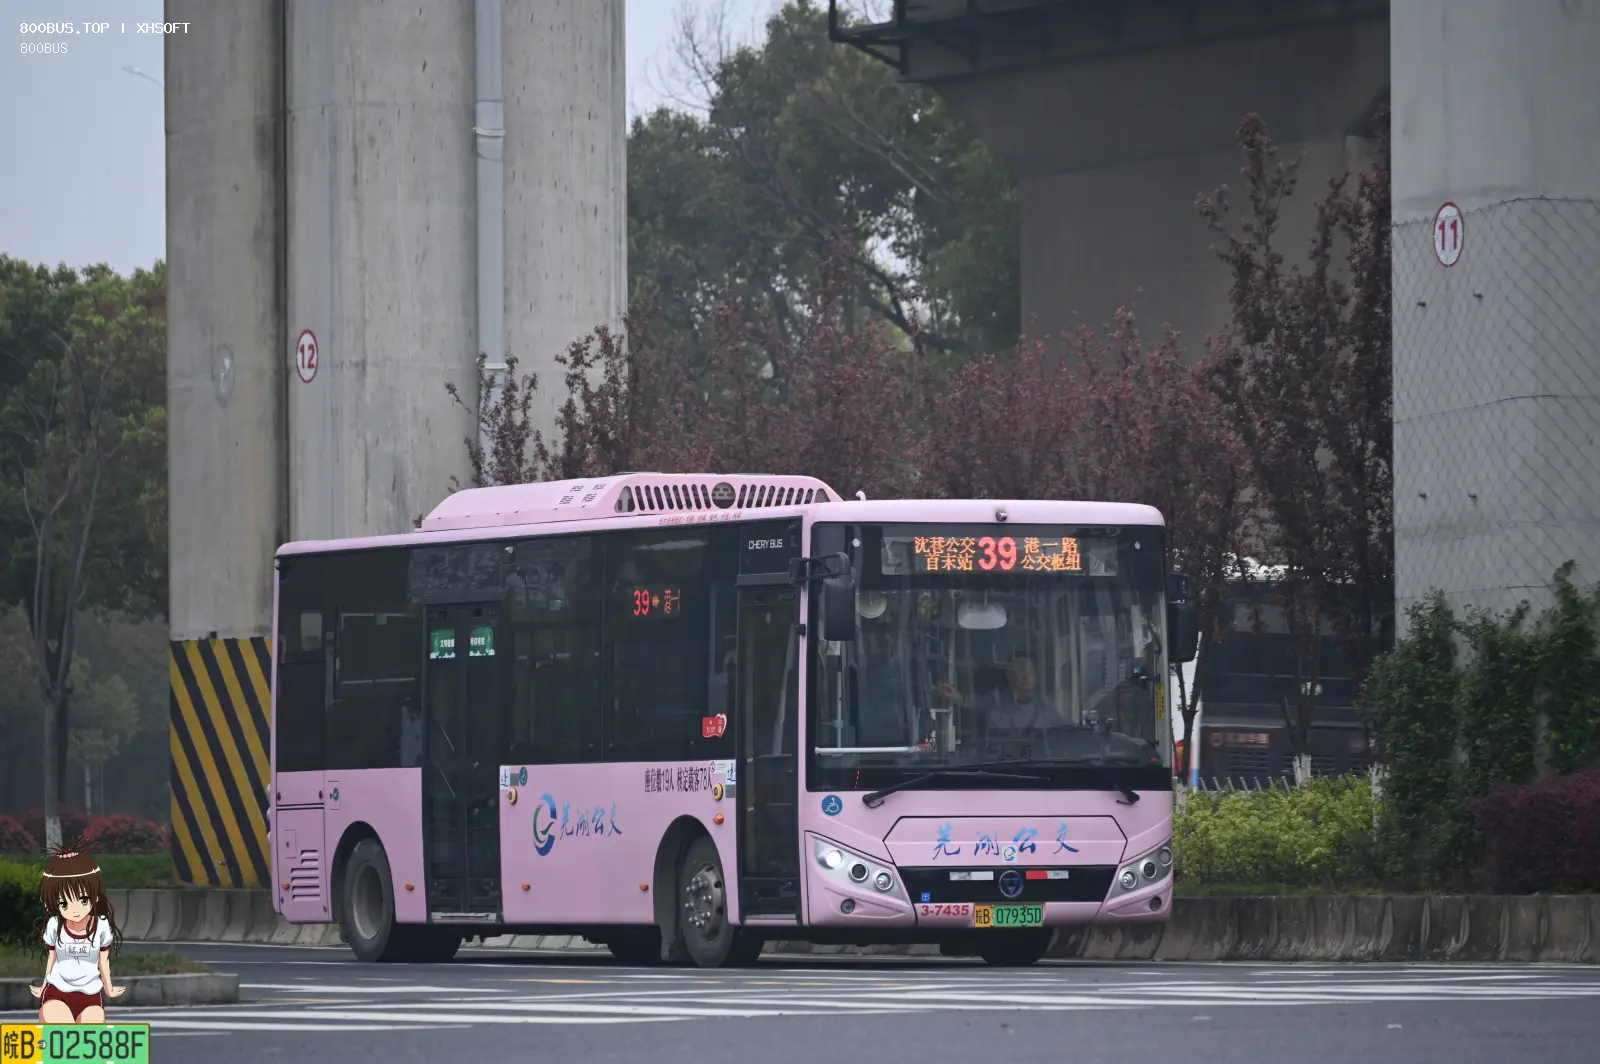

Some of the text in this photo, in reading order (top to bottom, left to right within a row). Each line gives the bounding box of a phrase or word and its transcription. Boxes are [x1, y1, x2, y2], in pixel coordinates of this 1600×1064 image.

[1438, 218, 1458, 251] 11
[299, 343, 315, 369] 12
[748, 538, 783, 550] CHERY BUS
[914, 536, 976, 554] 沈巷公交
[1023, 537, 1078, 554] 港一路
[924, 553, 973, 571] 首末站
[977, 536, 1017, 571] 39
[1020, 553, 1082, 571] 公交枢纽
[633, 589, 650, 616] 39
[920, 904, 970, 917] 3-7435
